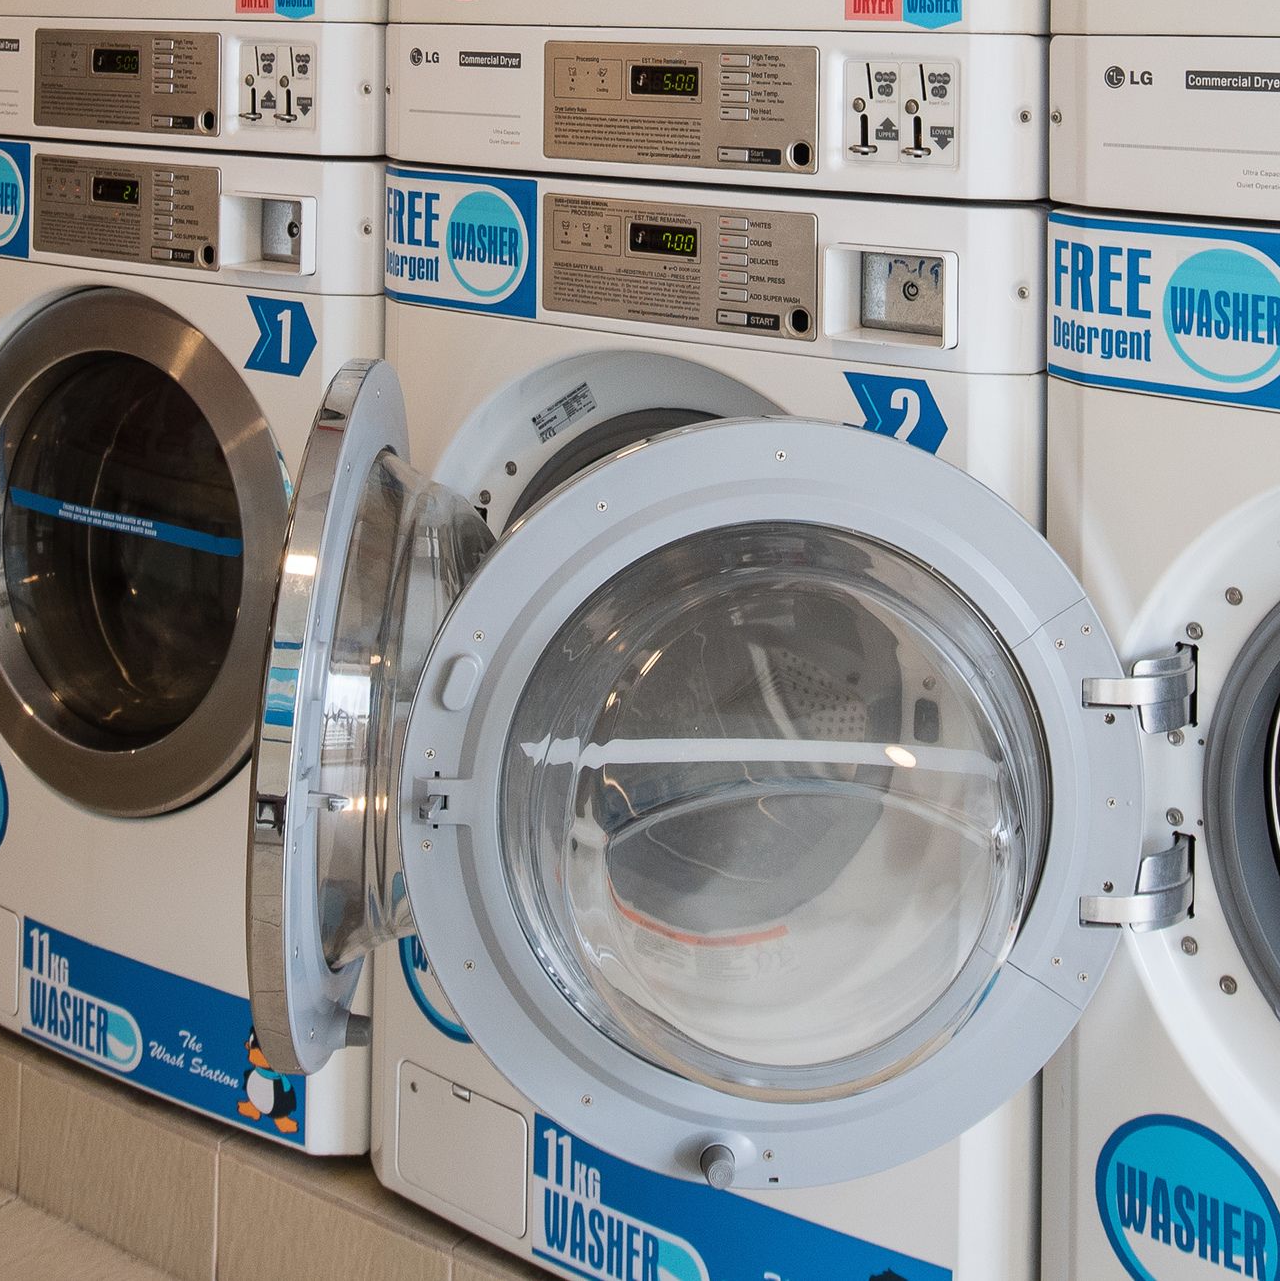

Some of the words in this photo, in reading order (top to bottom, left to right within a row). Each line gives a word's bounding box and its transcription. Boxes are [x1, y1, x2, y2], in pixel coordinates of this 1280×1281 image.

[6, 41, 19, 52] Dryer
[426, 52, 439, 63] LG
[460, 54, 499, 65] Commercial
[500, 56, 520, 67] Dryer
[663, 74, 695, 91] 5.00
[1130, 70, 1153, 86] LG
[1188, 74, 1251, 88] Commercial
[878, 130, 896, 138] UPPER
[932, 128, 952, 136] LOWER
[386, 187, 440, 248] FREE
[450, 221, 519, 267] WASHER
[662, 232, 695, 251] 7.00
[386, 248, 439, 282] Detergent
[1054, 239, 1151, 319] FREE
[276, 309, 292, 363] 1
[750, 316, 774, 327] START
[1053, 314, 1151, 362] Detergent
[890, 388, 920, 444] 2
[29, 927, 69, 987] 11KG
[29, 978, 108, 1058] WASHER
[179, 1030, 203, 1053] The
[149, 1042, 185, 1070] Wash
[190, 1058, 239, 1088] Station
[543, 1128, 600, 1204] 11KG
[545, 1187, 660, 1281] WASHER
[1116, 1161, 1268, 1280] WASHER
